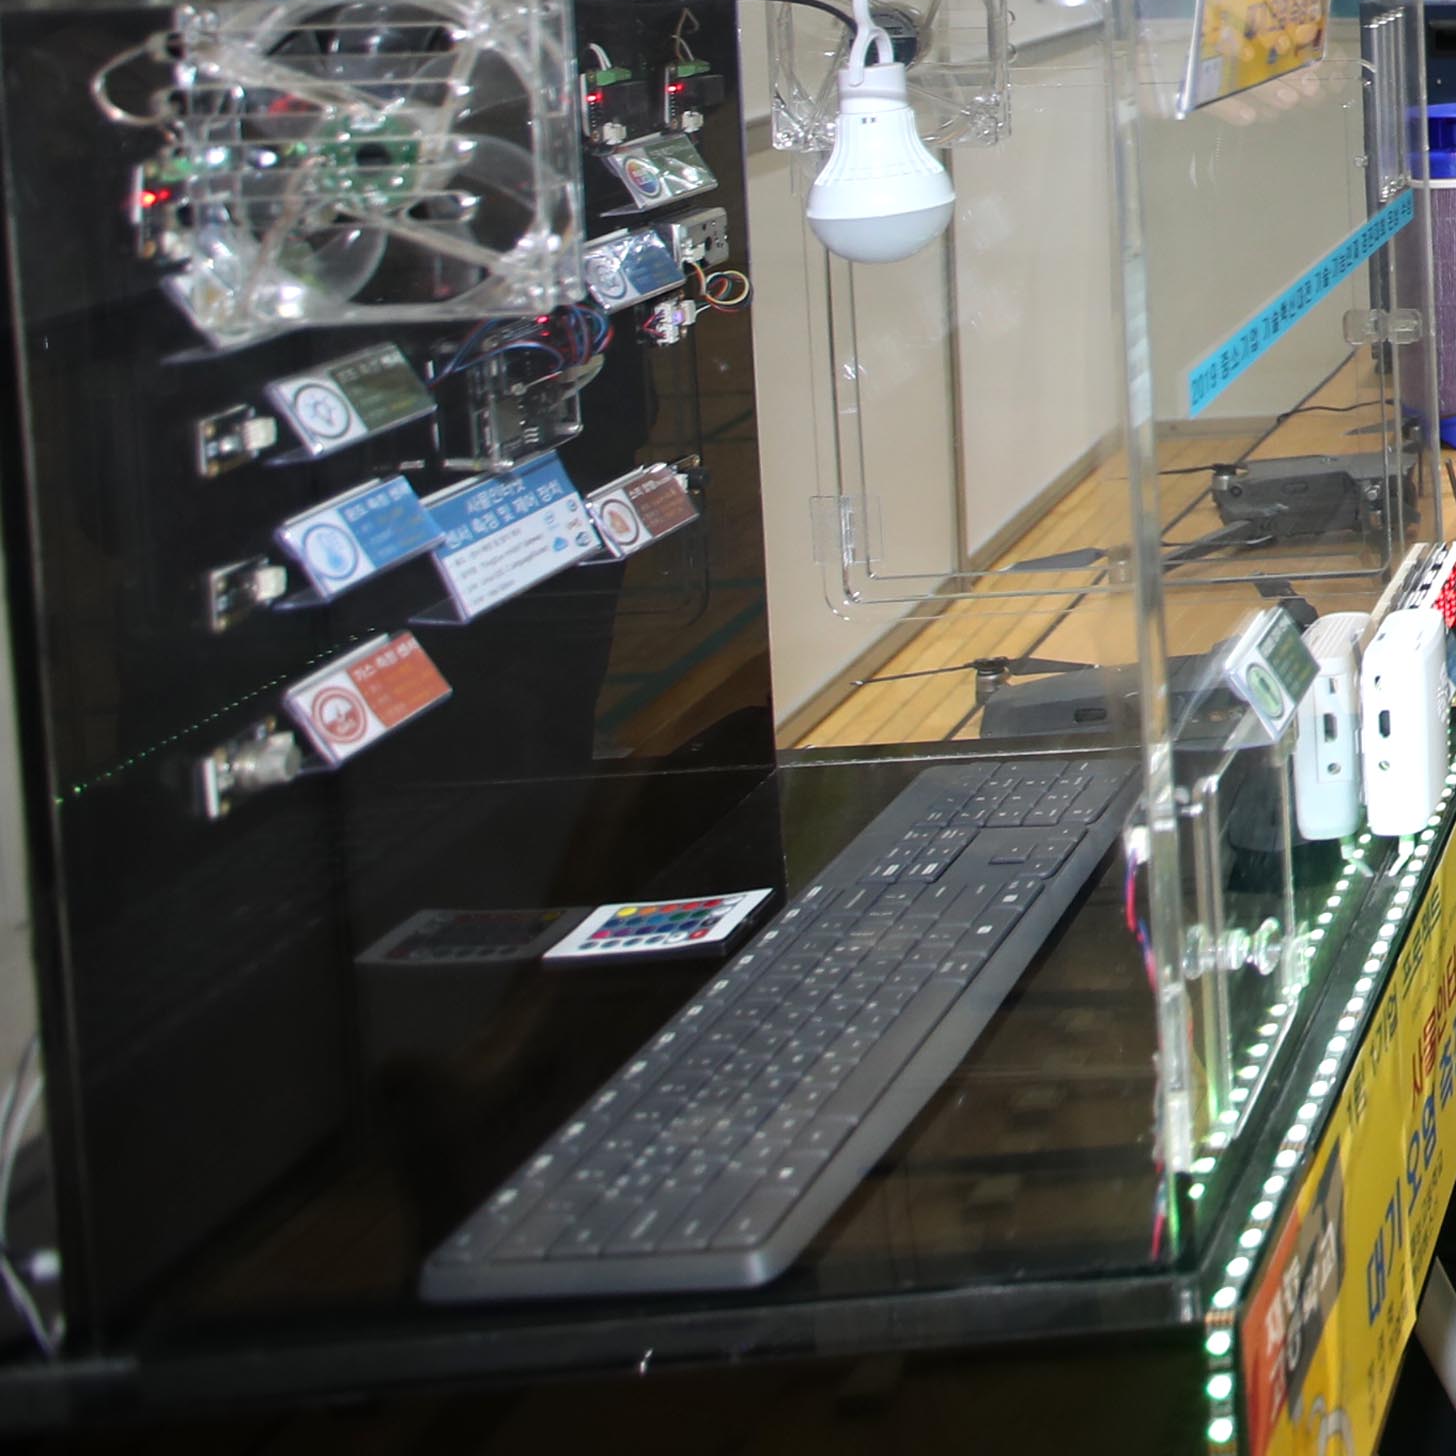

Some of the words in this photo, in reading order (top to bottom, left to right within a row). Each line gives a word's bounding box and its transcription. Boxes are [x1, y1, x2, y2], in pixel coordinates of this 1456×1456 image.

[472, 509, 499, 534] 측정
[538, 478, 564, 503] 장치
[1402, 884, 1442, 1000] 프로젝트
